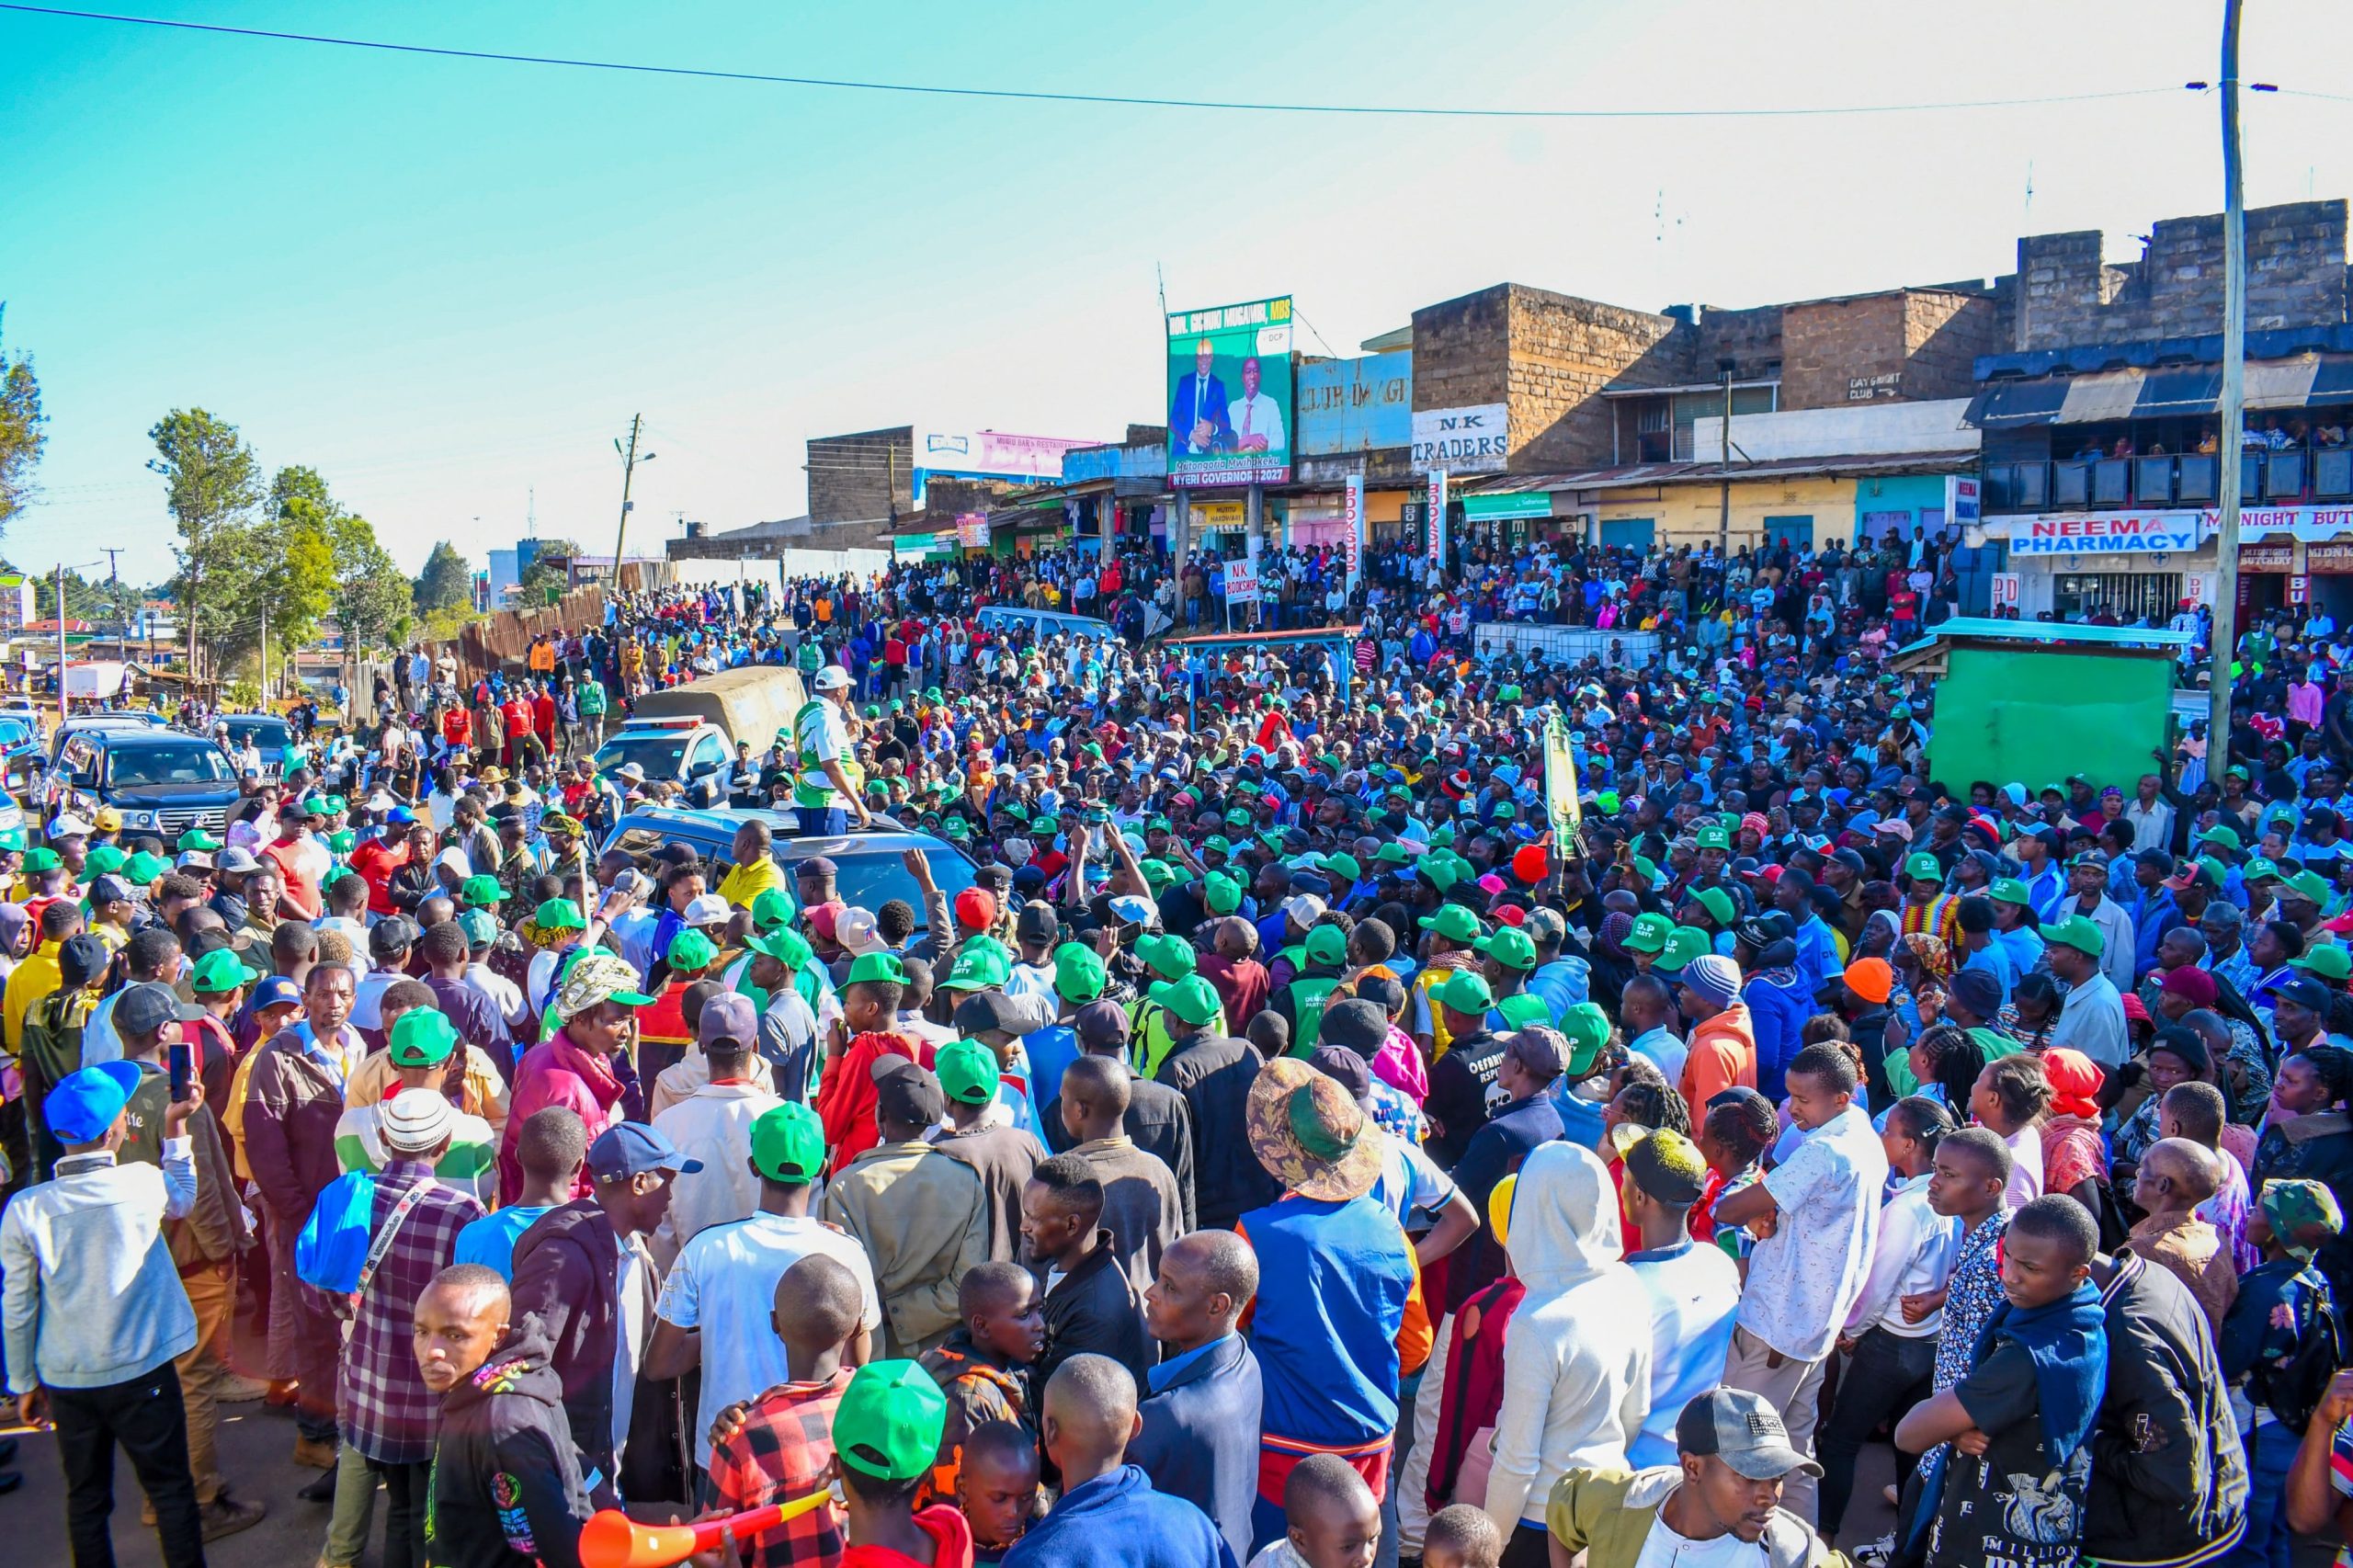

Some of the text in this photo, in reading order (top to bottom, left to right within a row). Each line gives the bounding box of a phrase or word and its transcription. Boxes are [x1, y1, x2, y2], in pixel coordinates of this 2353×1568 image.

[1270, 299, 1291, 321] MBS
[1268, 333, 1284, 343] DCP
[1849, 388, 1873, 400] CLUB
[1439, 415, 1485, 431] N.K
[1412, 435, 1507, 461] TRADERS
[1173, 469, 1283, 486] NYERI GOVERNOR 2027
[1428, 483, 1439, 561] BOOKSHO
[2031, 517, 2167, 537] NEEMA
[2206, 511, 2300, 528] MNIGHT
[1347, 486, 1357, 573] BOOKSHOP
[2012, 532, 2192, 552] PHARMACY
[2240, 556, 2293, 565] BUTCHERY
[1233, 562, 1248, 577] NK
[1226, 578, 1257, 595] BOOKSHOP
[1636, 930, 1653, 938] PARTY
[1637, 922, 1655, 933] D.P
[1989, 1539, 2078, 1560] MILLION
